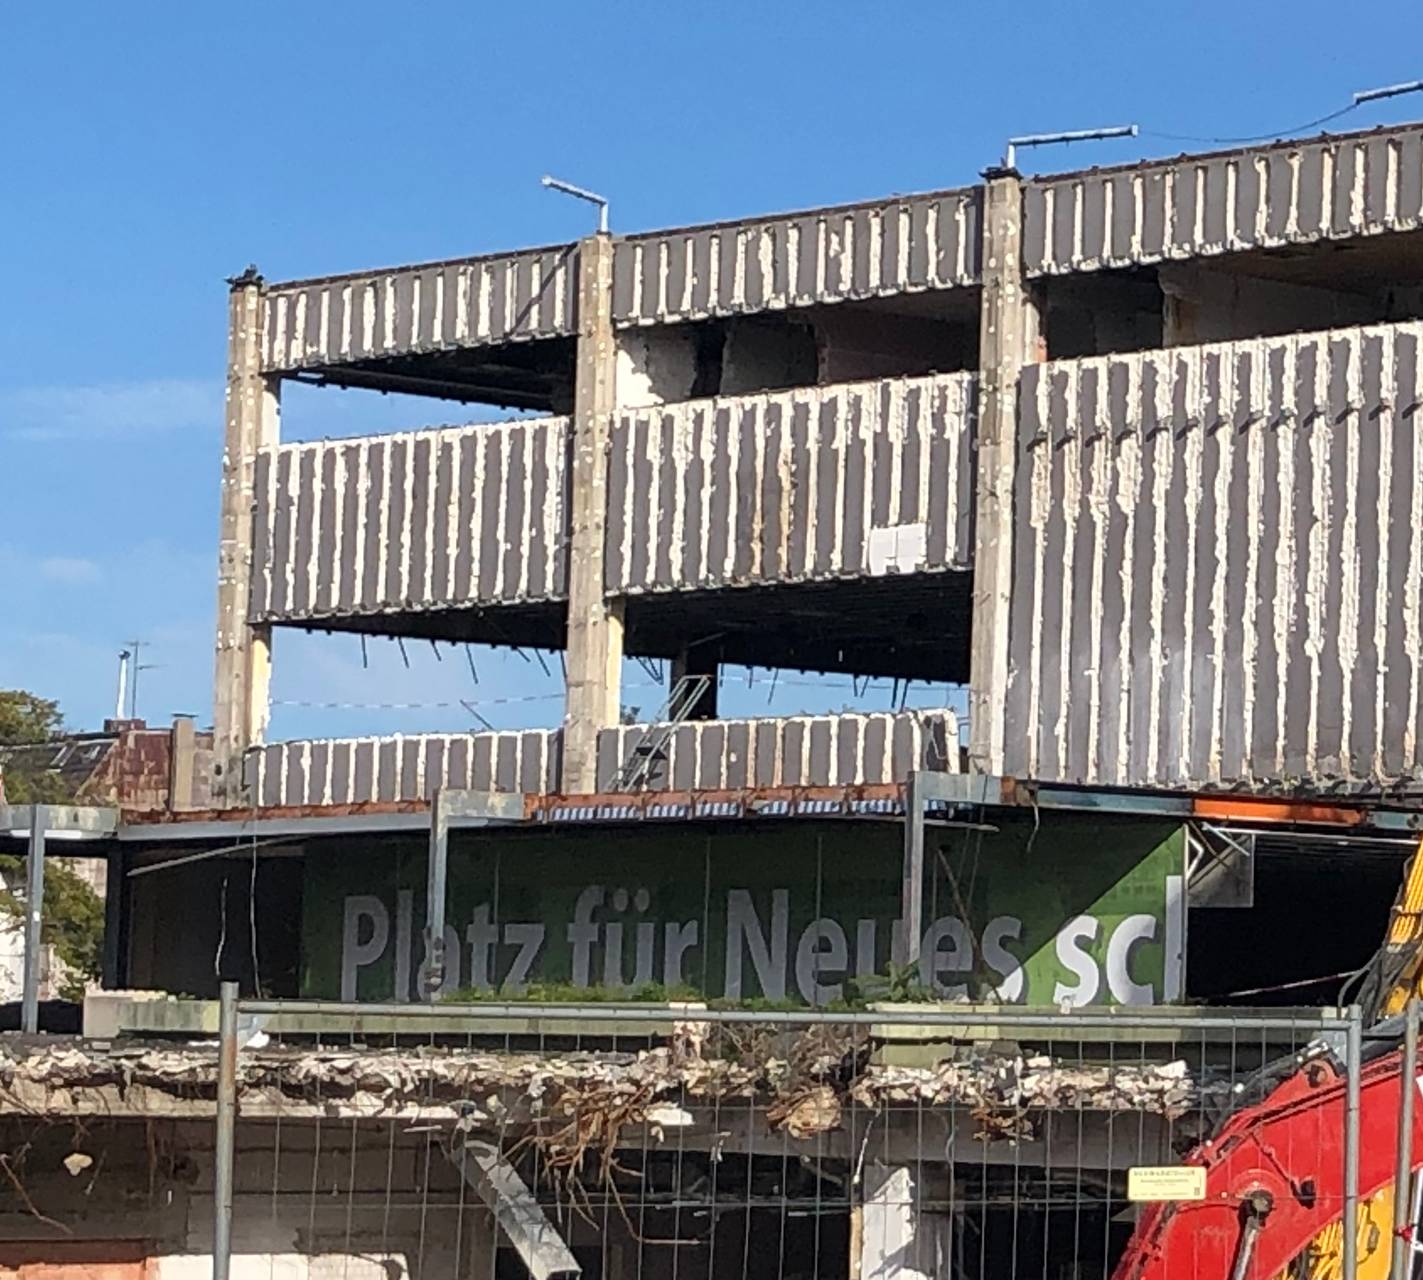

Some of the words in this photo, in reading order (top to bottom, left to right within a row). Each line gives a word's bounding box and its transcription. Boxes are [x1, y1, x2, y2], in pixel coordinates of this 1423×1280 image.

[341, 889, 545, 1001] Platz
[567, 885, 698, 990] für
[724, 888, 1024, 1007] Neues
